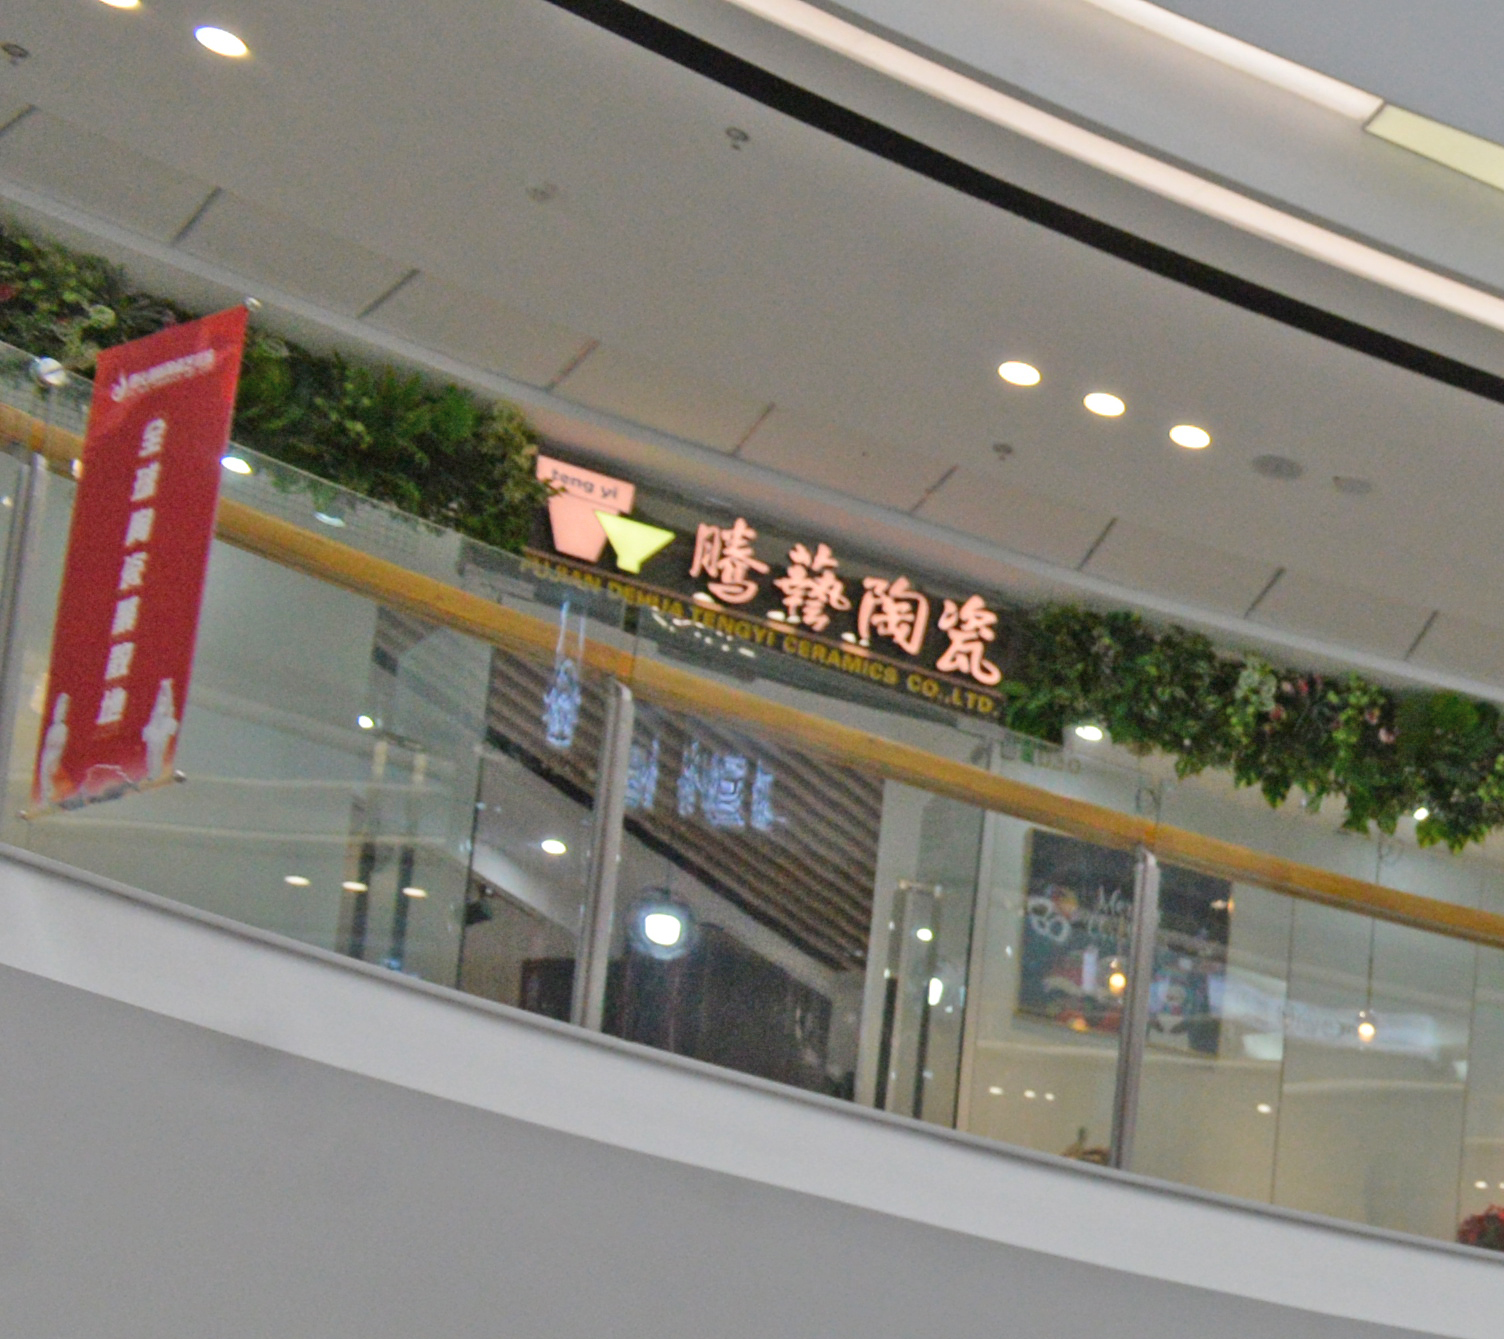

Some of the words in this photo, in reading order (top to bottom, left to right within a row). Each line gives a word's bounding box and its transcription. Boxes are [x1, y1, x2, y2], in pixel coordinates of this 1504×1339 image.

[551, 468, 595, 493] teng
[600, 483, 619, 499] yi
[607, 582, 685, 619] DEHUA
[692, 605, 777, 647] TENGYI
[783, 635, 899, 686] CERAMICS
